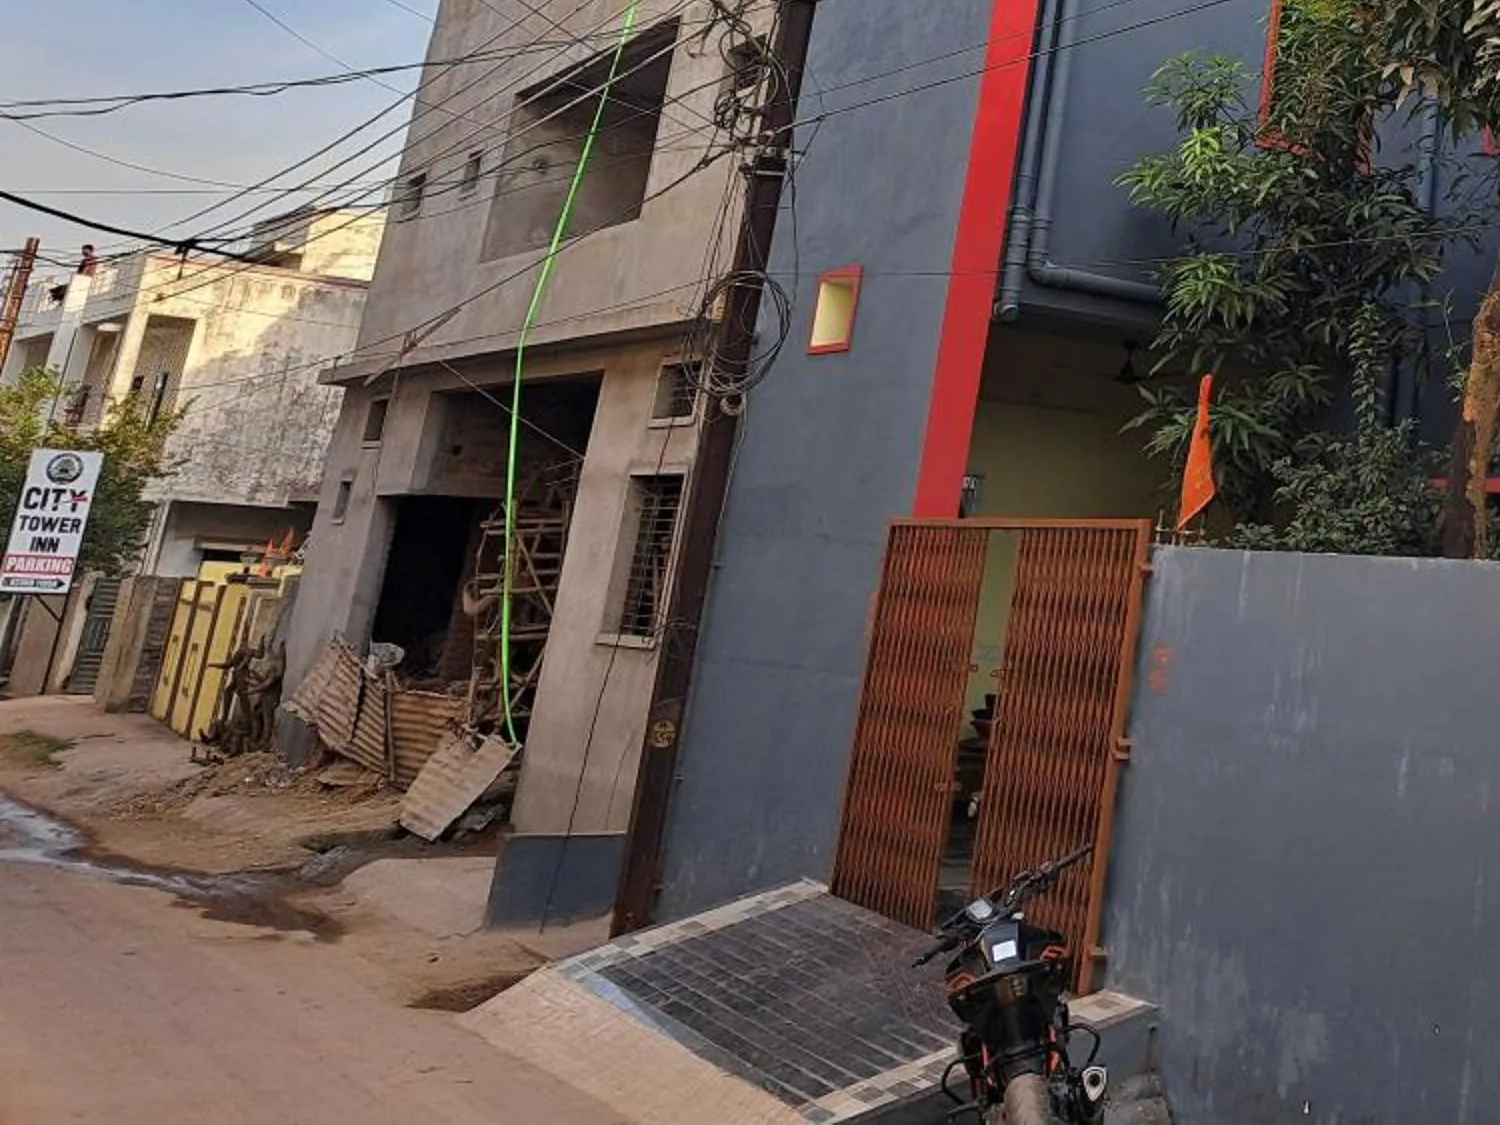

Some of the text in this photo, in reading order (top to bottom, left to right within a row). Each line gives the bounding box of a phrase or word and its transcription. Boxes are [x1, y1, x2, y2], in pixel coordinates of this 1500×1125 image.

[23, 486, 88, 513] CITY
[19, 514, 82, 534] TOWER
[29, 536, 61, 554] INN
[5, 556, 73, 574] PARKING
